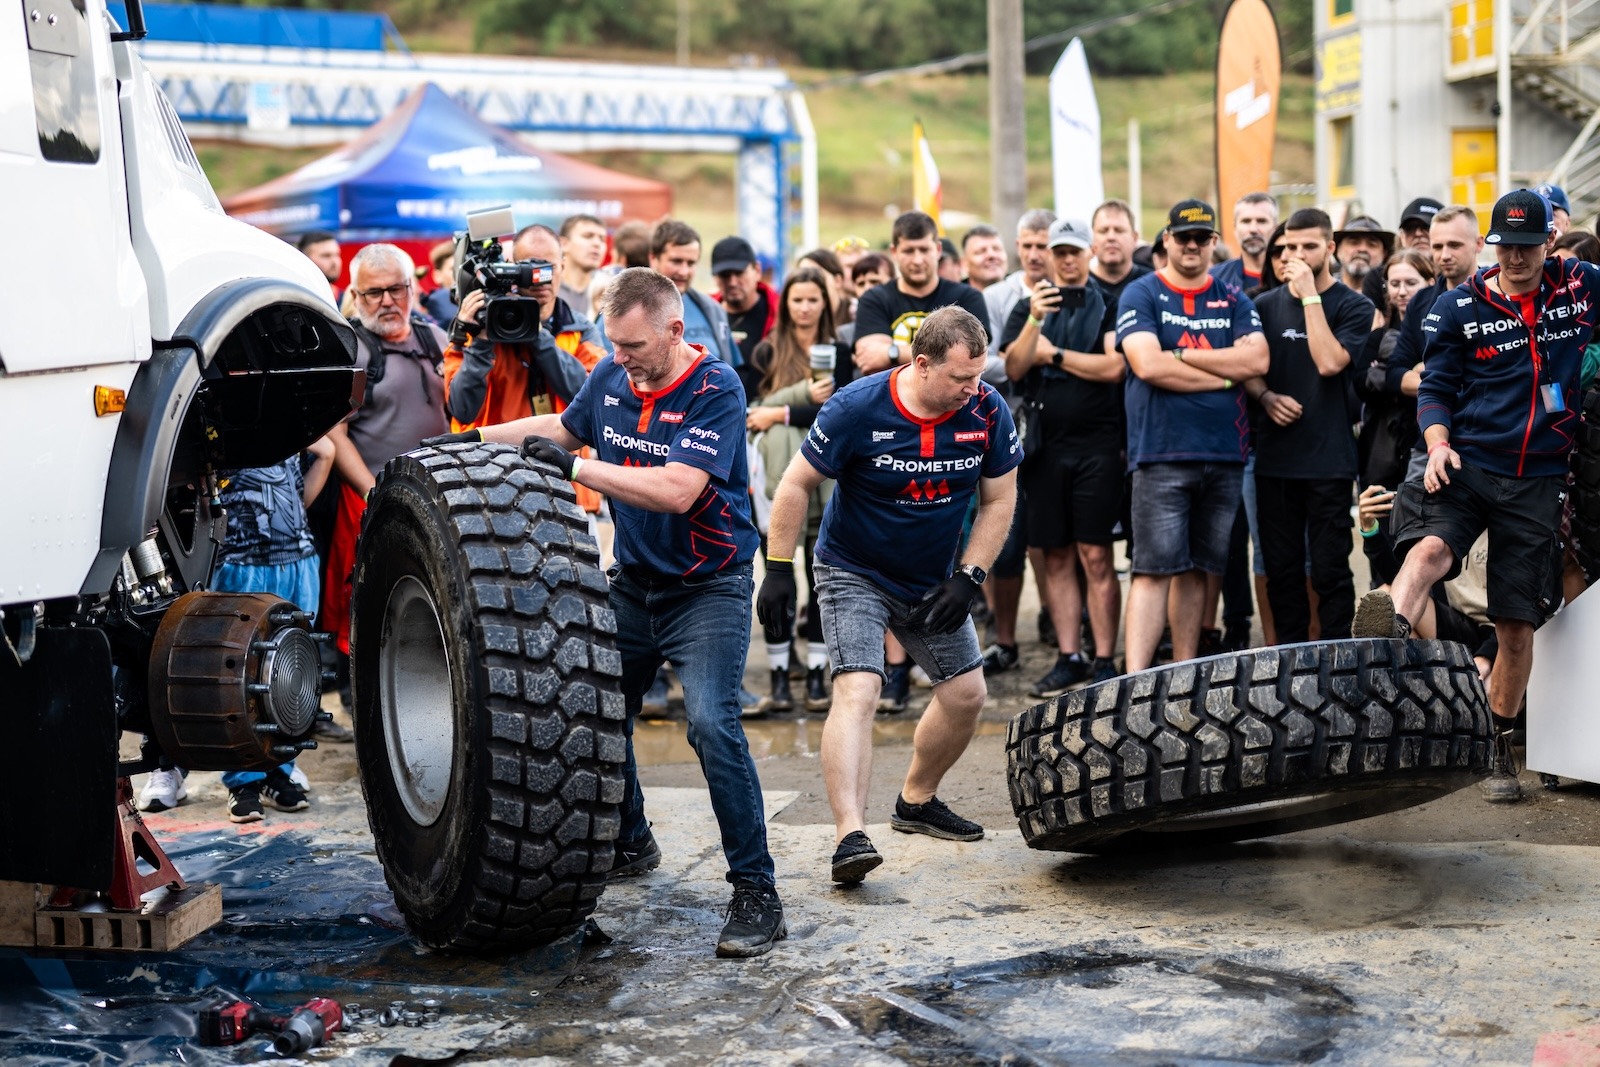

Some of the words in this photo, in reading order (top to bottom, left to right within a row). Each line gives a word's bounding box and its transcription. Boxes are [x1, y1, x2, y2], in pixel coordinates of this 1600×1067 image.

[1496, 327, 1582, 353] TECHNOLOGY
[602, 425, 671, 457] PROMETEO
[691, 441, 719, 456] Castrol
[872, 453, 985, 473] PROMETEON
